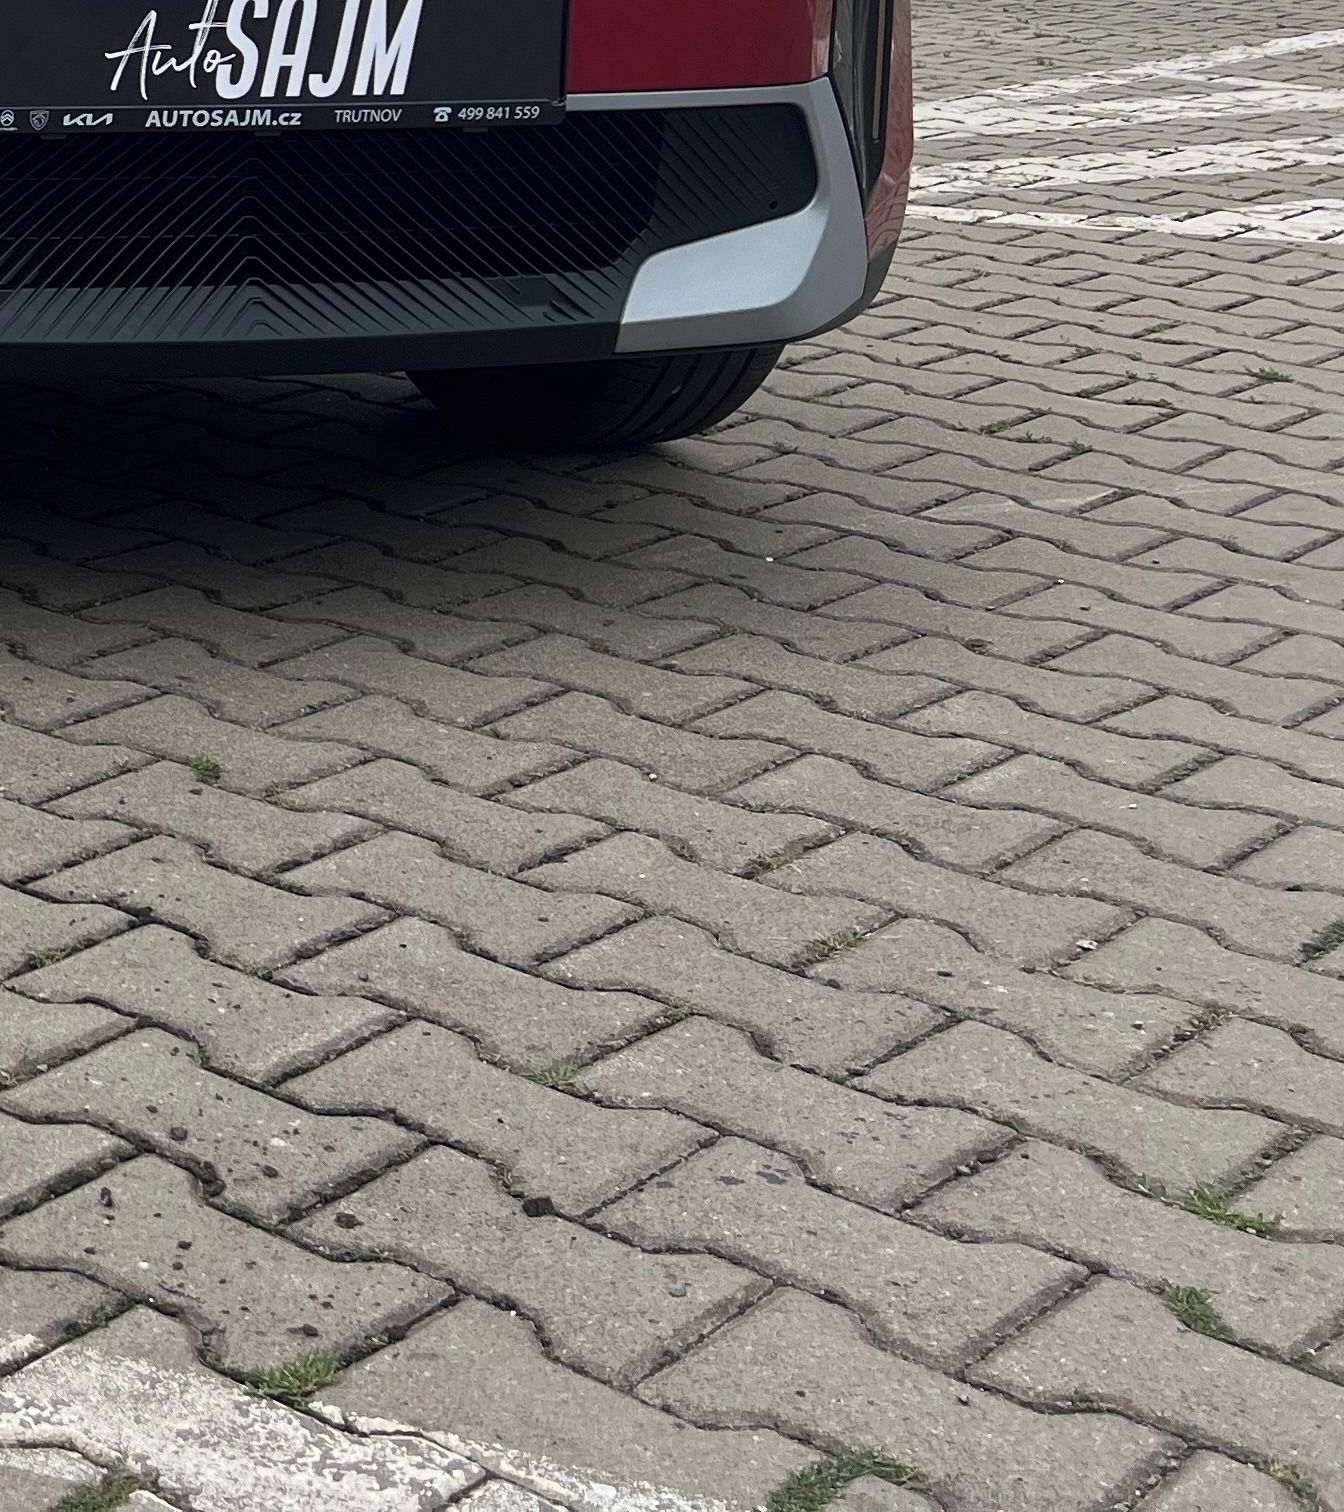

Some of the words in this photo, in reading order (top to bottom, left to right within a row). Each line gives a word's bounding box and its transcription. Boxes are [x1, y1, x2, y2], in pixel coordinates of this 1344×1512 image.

[145, 109, 302, 128] AUTOSAJM.cz
[334, 109, 403, 124] TRUTNOV
[457, 107, 484, 120] 499
[486, 106, 510, 120] 841
[514, 105, 540, 119] 559
